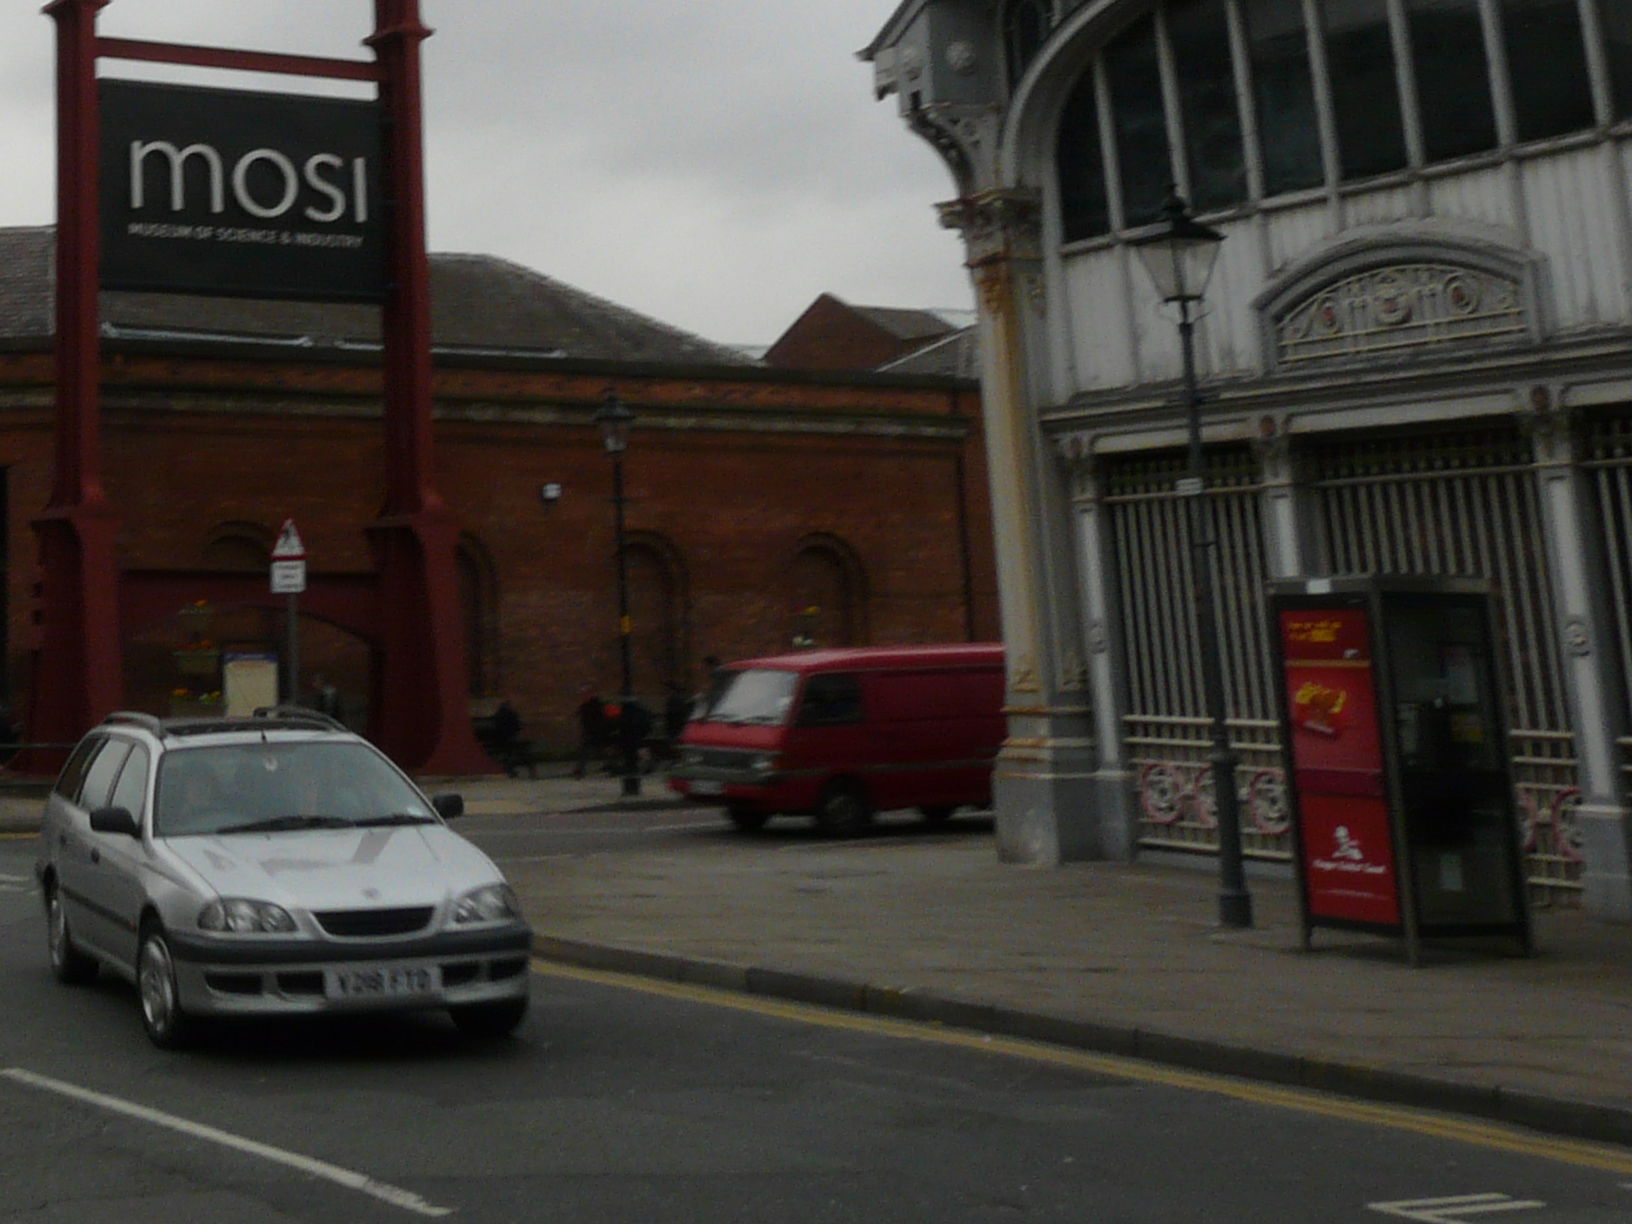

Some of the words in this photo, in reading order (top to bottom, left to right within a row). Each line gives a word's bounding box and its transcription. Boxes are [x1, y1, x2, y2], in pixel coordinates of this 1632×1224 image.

[128, 222, 193, 239] MUSEUM
[194, 225, 213, 240] OF
[216, 226, 279, 244] SCIENCE
[280, 230, 293, 245] &
[295, 232, 365, 249] INDUSTRY
